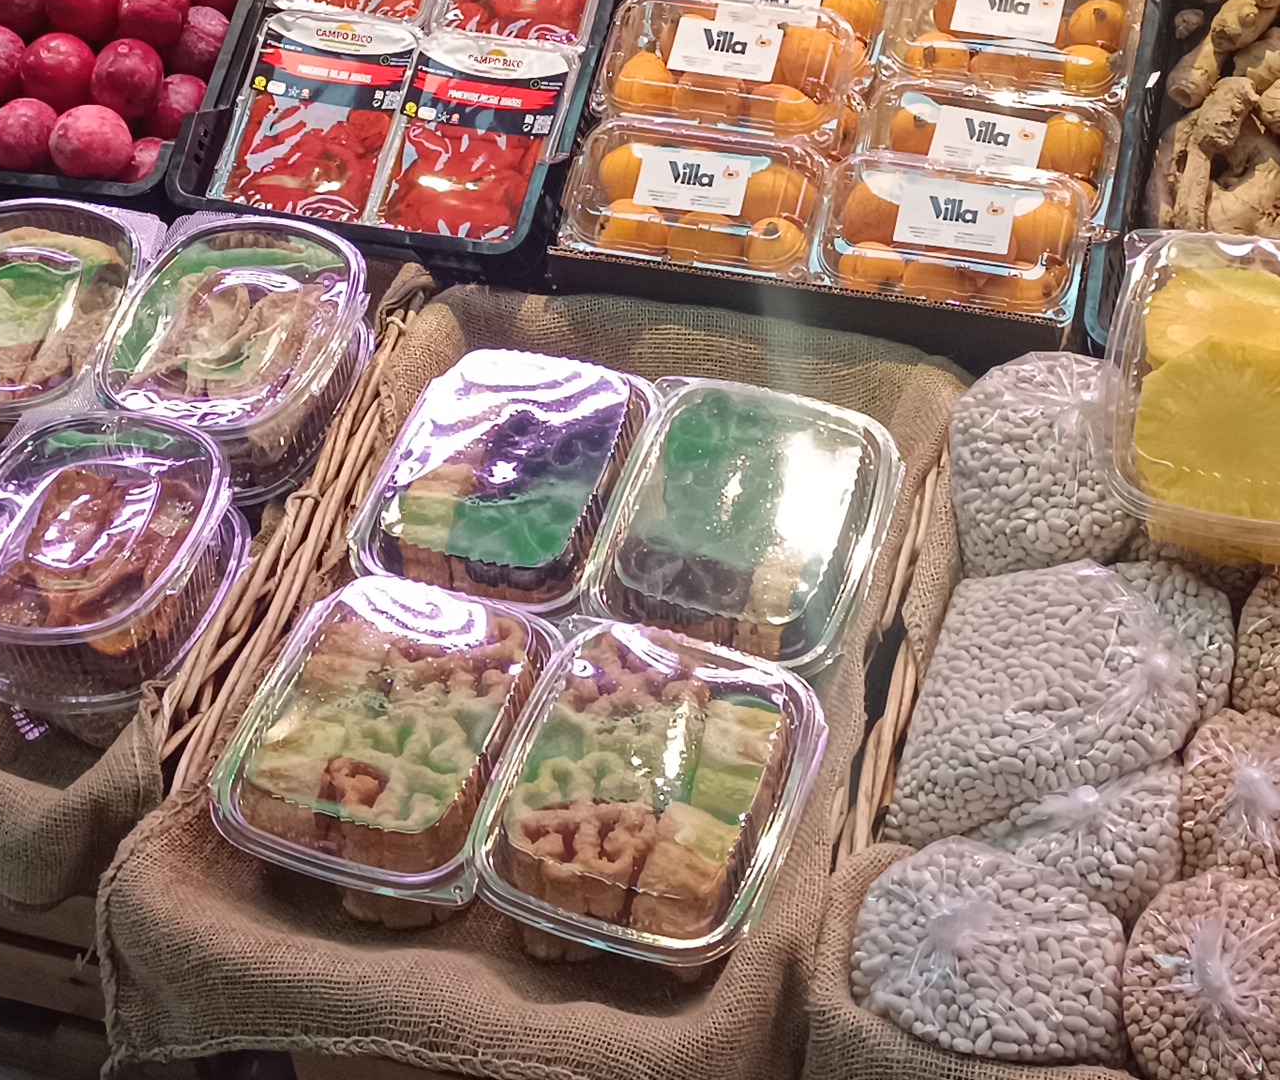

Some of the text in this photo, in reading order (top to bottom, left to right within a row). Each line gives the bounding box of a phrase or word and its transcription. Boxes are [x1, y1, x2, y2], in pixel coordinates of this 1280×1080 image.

[315, 28, 373, 44] CAMPO RICO
[703, 27, 748, 56] Villa
[501, 58, 524, 69] RICO
[965, 116, 1011, 148] Villa
[668, 160, 715, 189] Villa
[928, 195, 978, 226] Villa
